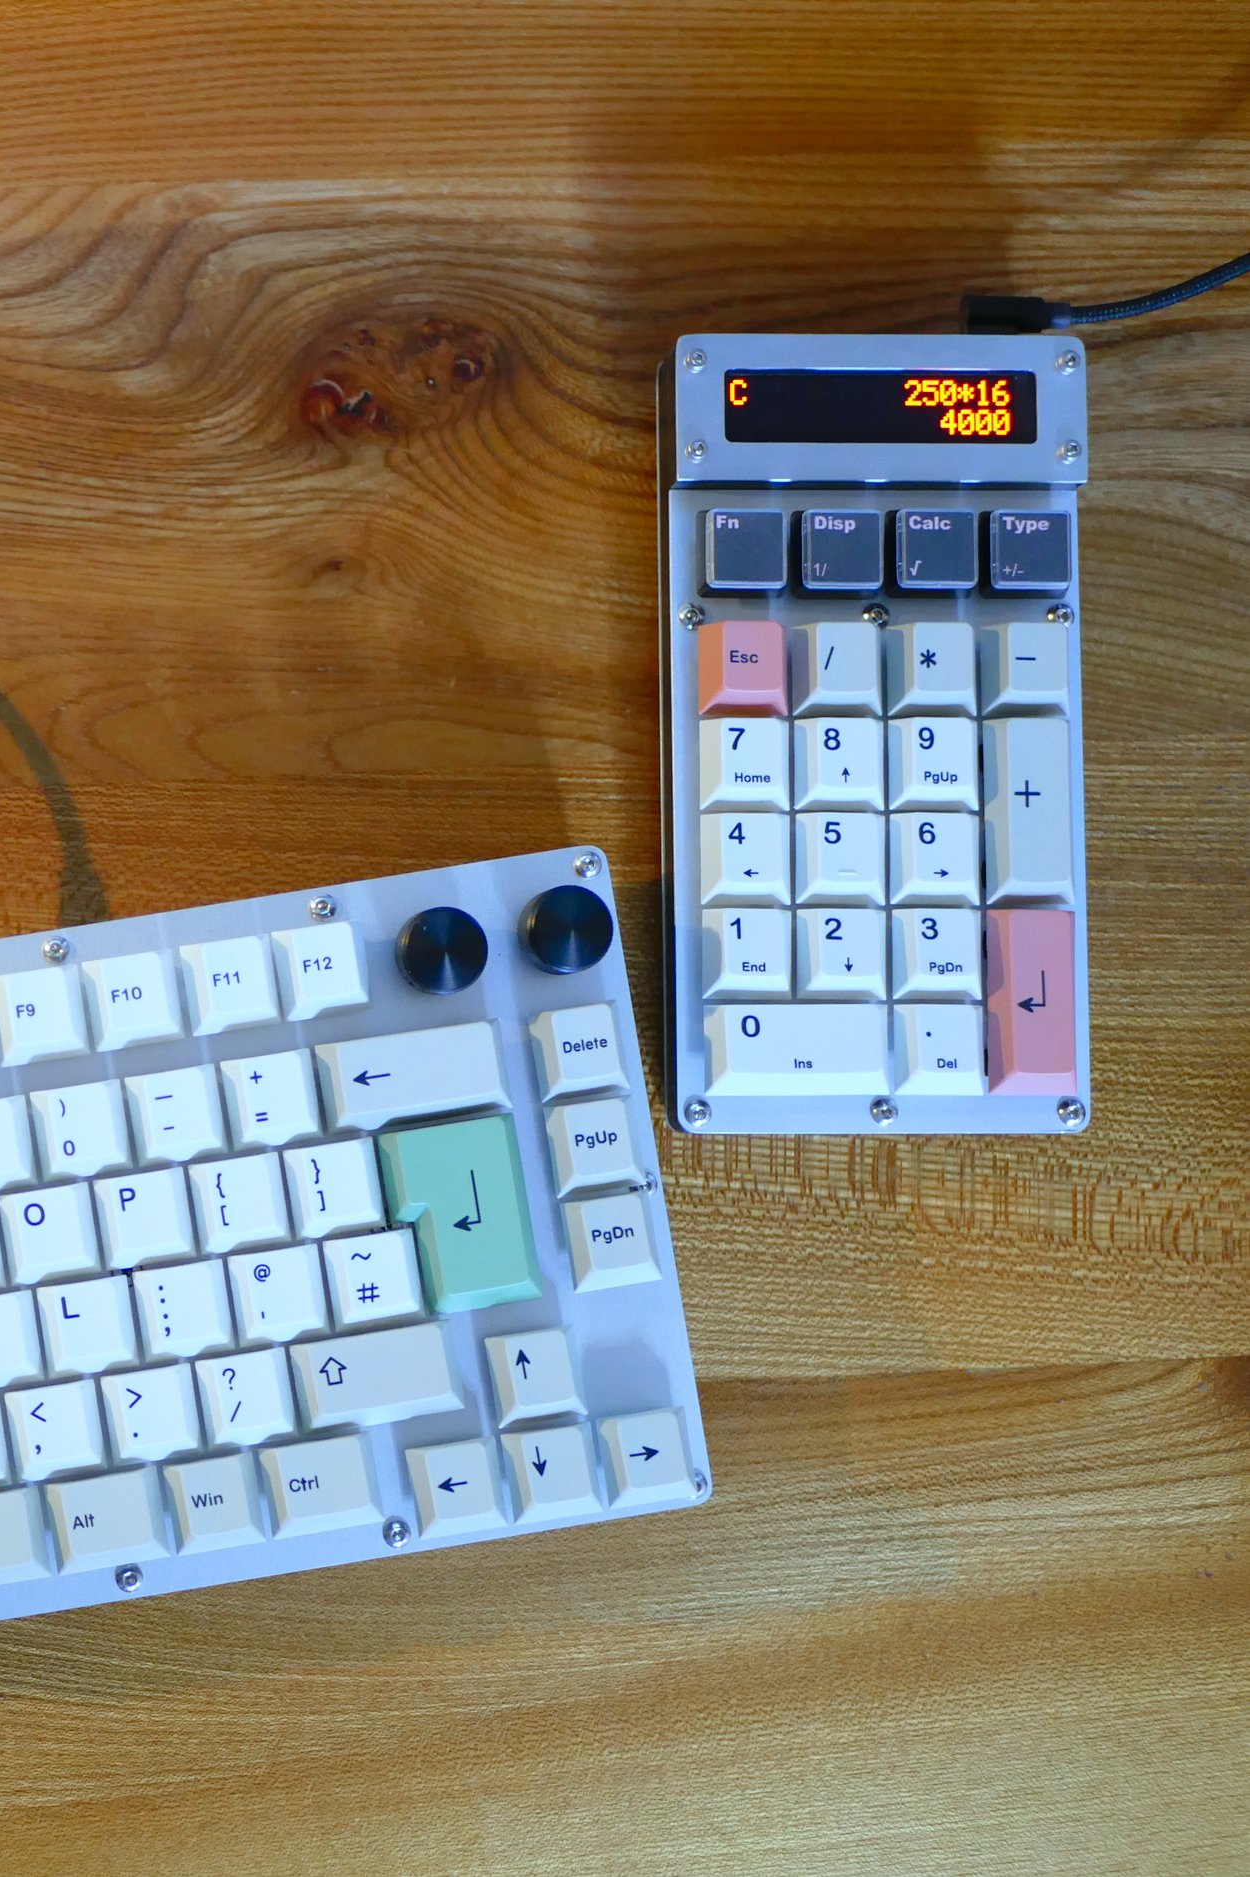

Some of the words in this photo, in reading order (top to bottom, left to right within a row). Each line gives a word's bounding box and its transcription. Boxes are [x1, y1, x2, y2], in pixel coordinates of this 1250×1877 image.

[729, 379, 748, 406] C
[940, 409, 1011, 436] 4000
[716, 515, 740, 529] Fn
[814, 515, 856, 534] Disp
[908, 515, 951, 531] Calc
[1002, 516, 1050, 534] Type
[730, 650, 758, 663] Esc
[728, 727, 745, 750] 7
[824, 728, 841, 751] 8
[918, 727, 934, 750] 9
[735, 772, 770, 783] Home
[924, 771, 958, 784] PgUp
[728, 822, 745, 845] 4
[824, 821, 841, 844] 5
[919, 822, 936, 844] 6
[730, 918, 741, 940] 1
[825, 918, 843, 940] 2
[921, 918, 938, 940] 3
[303, 957, 332, 973] F12
[742, 962, 766, 972] End
[929, 962, 962, 975] PgDn
[213, 971, 240, 987] F11
[111, 987, 142, 1003] F10
[16, 1004, 35, 1018] F9
[563, 1038, 607, 1053] Delete
[794, 1058, 813, 1069] Ins
[937, 1058, 957, 1068] Del
[250, 1071, 262, 1084] +
[575, 1130, 617, 1148] PgUp
[119, 1188, 136, 1211] P
[24, 1203, 45, 1226] O
[591, 1226, 634, 1244] PgDn
[253, 1264, 271, 1282] @
[356, 1283, 380, 1303] #
[61, 1296, 80, 1319] L
[222, 1368, 235, 1390] ?
[289, 1475, 319, 1492] Ctrl
[191, 1493, 223, 1508] Win
[73, 1514, 94, 1530] Alt
